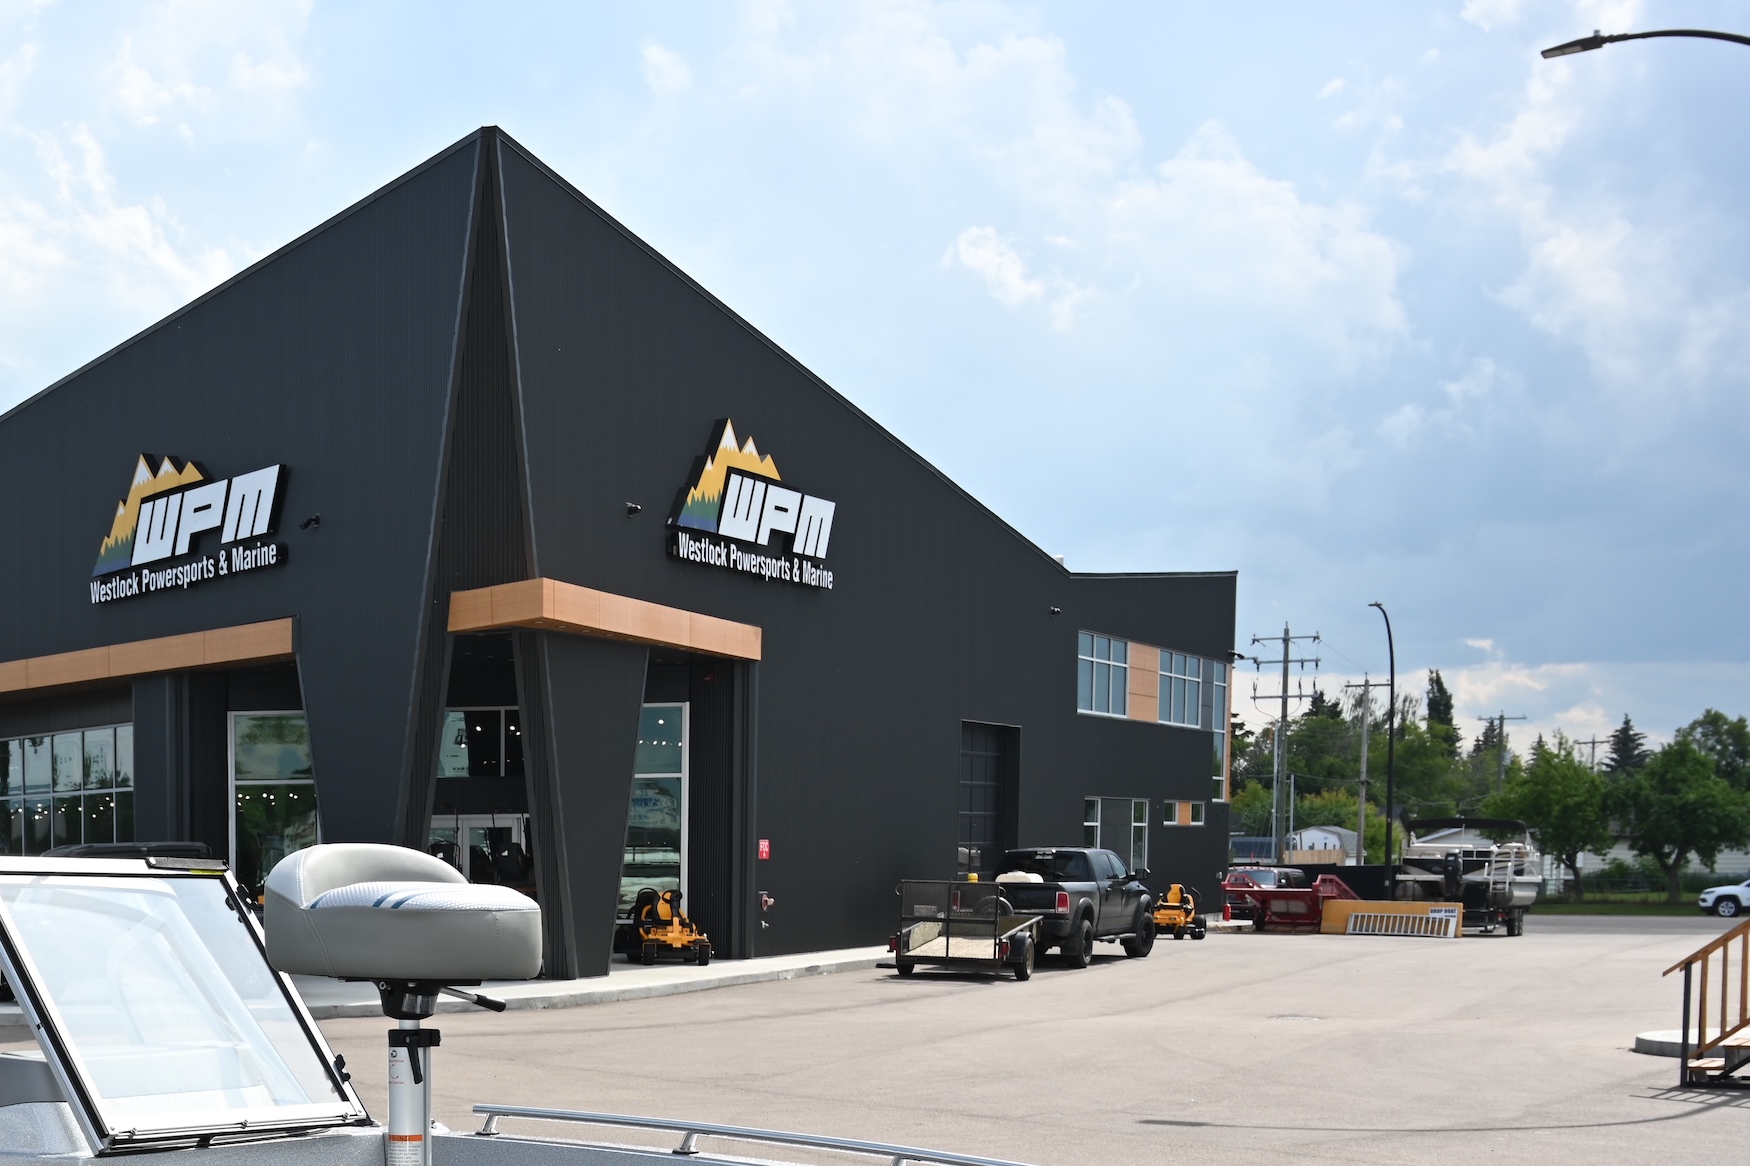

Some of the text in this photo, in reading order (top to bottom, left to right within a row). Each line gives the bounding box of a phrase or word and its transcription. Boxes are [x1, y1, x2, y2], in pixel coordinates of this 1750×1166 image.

[131, 464, 280, 566] WPM
[718, 473, 836, 559] WPM
[90, 542, 277, 604] Westlock Powersports & Marine
[678, 531, 833, 590] Westlock Powersports & Marine
